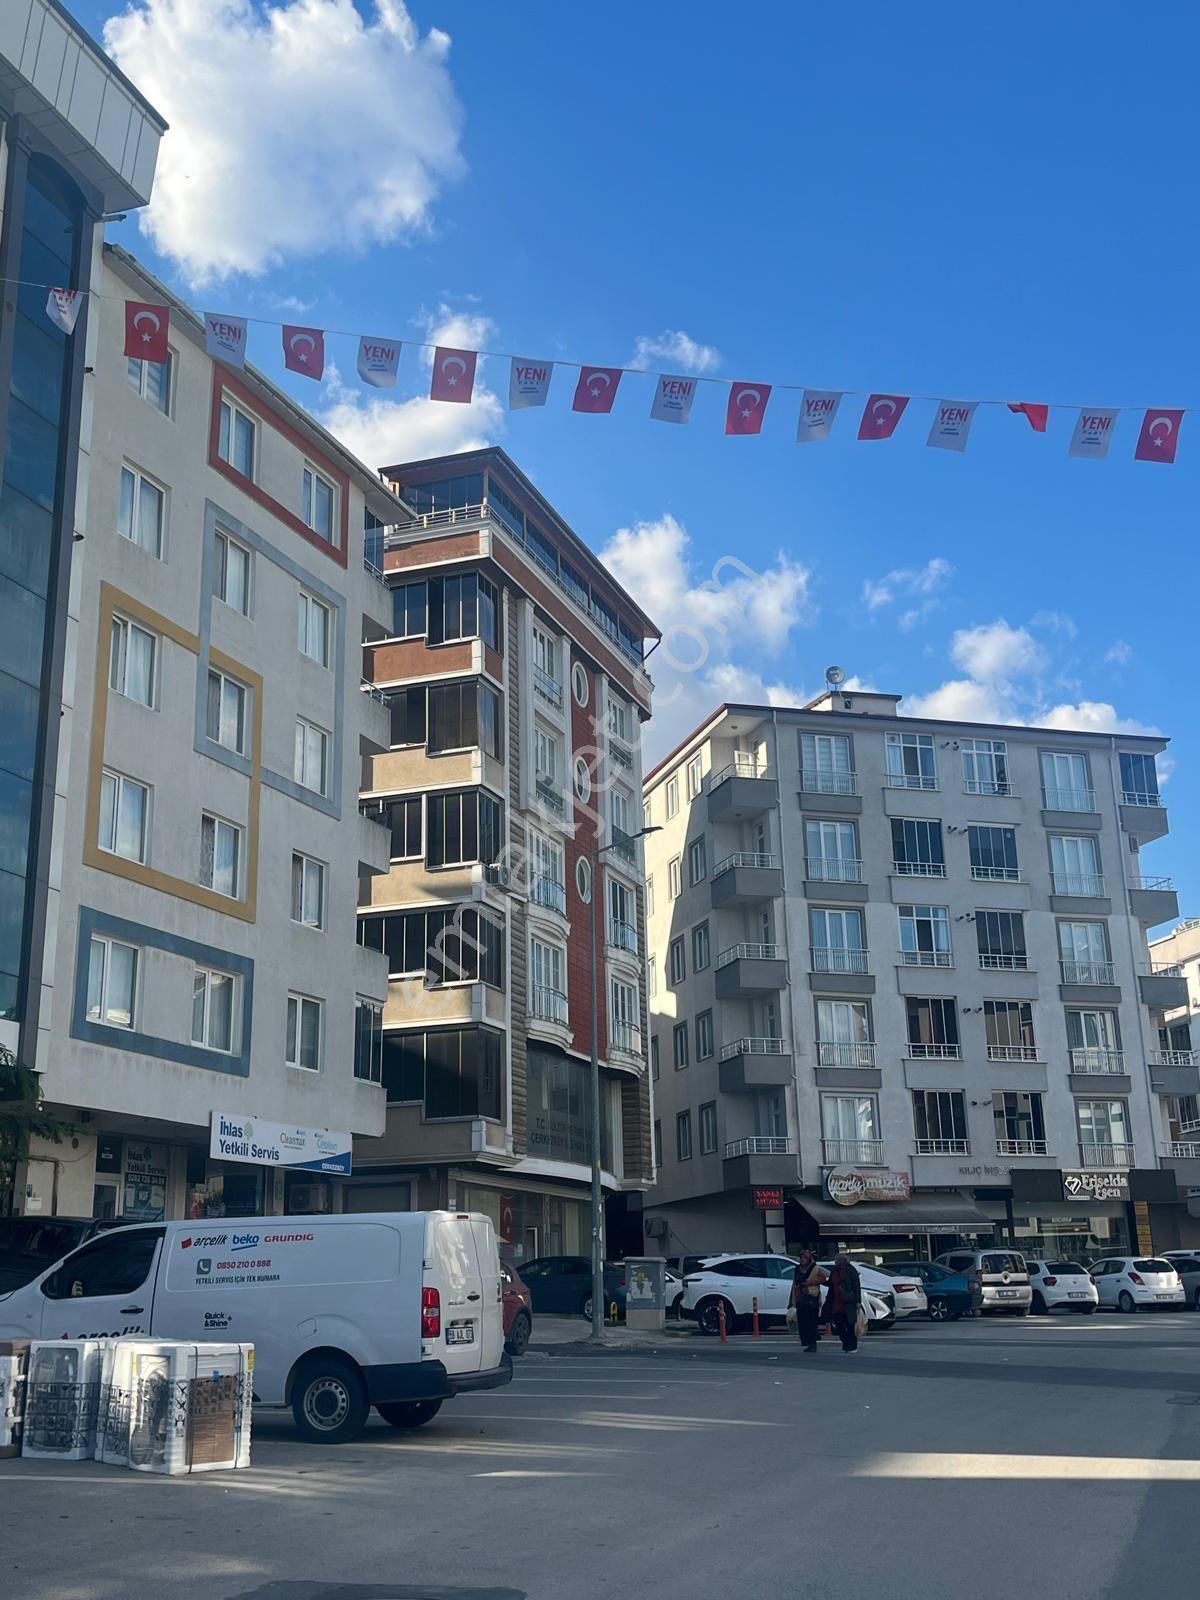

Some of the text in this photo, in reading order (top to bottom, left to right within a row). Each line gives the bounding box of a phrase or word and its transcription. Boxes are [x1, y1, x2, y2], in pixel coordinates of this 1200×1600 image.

[220, 1115, 243, 1138] İhlas
[219, 1139, 280, 1161] Yetkili Servis
[193, 1234, 229, 1249] arçelik
[231, 1233, 260, 1247] beko
[264, 1233, 314, 1243] GRUNDIG
[216, 1259, 271, 1270] 0850 210 0 888
[246, 1275, 256, 1283] TEK
[257, 1274, 280, 1282] NUMARA
[204, 1312, 225, 1320] Quick
[204, 1319, 228, 1328] &Shine
